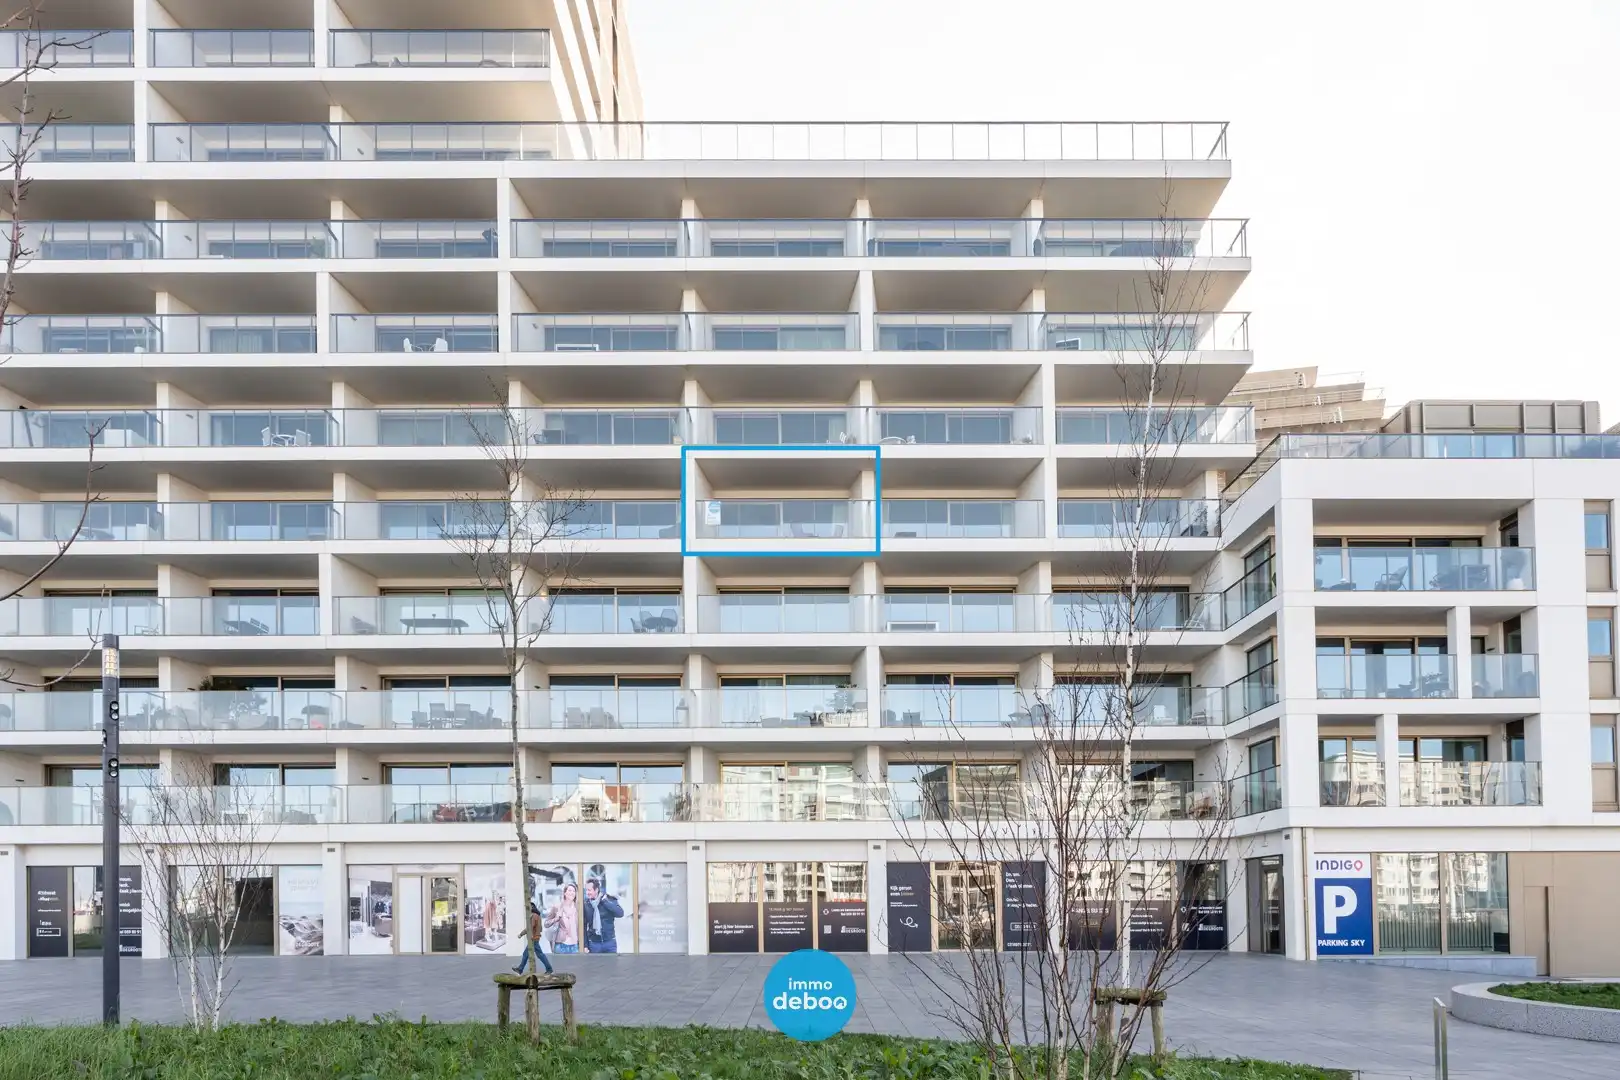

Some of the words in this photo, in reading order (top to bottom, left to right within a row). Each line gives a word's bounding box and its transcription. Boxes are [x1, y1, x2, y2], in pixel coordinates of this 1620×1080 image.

[1316, 860, 1363, 871] INDIGO
[1323, 885, 1358, 934] P
[1317, 939, 1349, 947] PARKING
[1350, 939, 1365, 947] SKY
